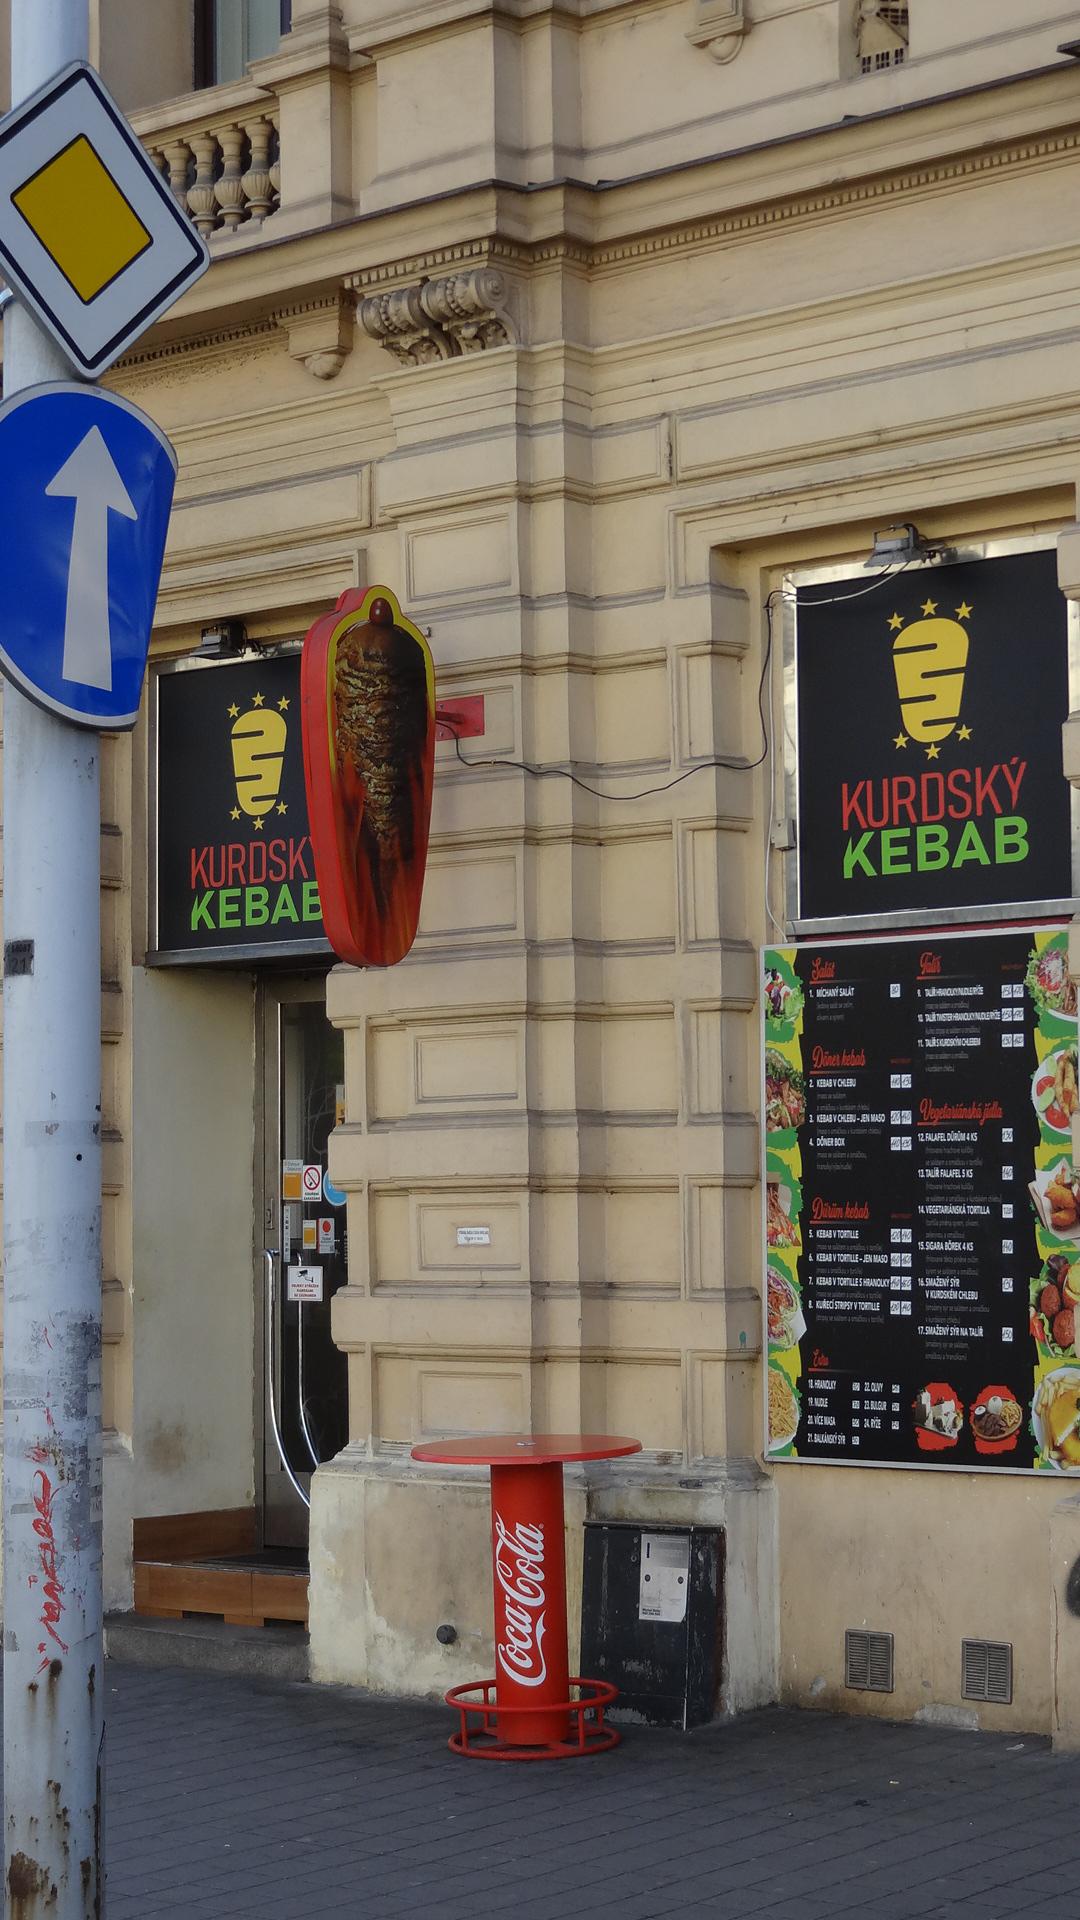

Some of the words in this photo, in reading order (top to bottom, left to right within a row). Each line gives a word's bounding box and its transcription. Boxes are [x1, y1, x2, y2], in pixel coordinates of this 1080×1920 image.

[842, 756, 1027, 831] KURDSKÝ
[843, 816, 1030, 879] KEBAB
[190, 835, 313, 890] KURDSK
[190, 881, 324, 931] KEBAB
[816, 987, 838, 997] MÍCHANÝ
[840, 986, 855, 997] SALÁT
[812, 1045, 840, 1068] Döner
[841, 1048, 866, 1066] kebab
[809, 1079, 814, 1088] 2.
[816, 1079, 832, 1087] KEBAB
[838, 1078, 856, 1087] CHLEBU
[816, 1114, 832, 1122] KEBAB
[838, 1114, 856, 1122] CHLEBU
[860, 1114, 870, 1122] JEN
[870, 1114, 886, 1122] MASO
[816, 1136, 834, 1146] DÖNER
[834, 1138, 845, 1146] BOX
[926, 1132, 946, 1141] FALAFEL
[947, 1131, 966, 1141] DÜRÜM
[970, 1132, 978, 1141] KS
[925, 1167, 940, 1178] TALÍŘ
[940, 1169, 961, 1178] FALAFEL
[966, 1169, 973, 1178] KS
[812, 1197, 843, 1220] Dürüm
[845, 1200, 869, 1219] kebab
[926, 1204, 966, 1214] VEGETARIÁNSKÁ
[967, 1206, 990, 1214] TORTILLA
[816, 1230, 832, 1238] KEBAB
[837, 1230, 859, 1238] TORTILLE
[926, 1242, 944, 1250] SIGARA
[945, 1240, 962, 1250] BÖREK
[967, 1242, 974, 1251] KS
[816, 1253, 832, 1262] KEBAB
[837, 1254, 858, 1263] TORTILLE
[863, 1255, 872, 1263] JEN
[873, 1255, 888, 1263] MASO
[809, 1276, 813, 1285] 7.
[816, 1277, 832, 1286] KEBAB
[837, 1278, 858, 1286] TORTILLE
[863, 1278, 890, 1287] HRANOLKY
[926, 1276, 949, 1287] SMAŽENÝ
[950, 1276, 960, 1287] SÝR
[930, 1290, 958, 1300] KURDSKÉM
[958, 1291, 978, 1300] CHLEBU
[816, 1299, 834, 1309] KUŘECÍ
[835, 1301, 853, 1310] STRIPSY
[858, 1302, 880, 1311] TORTILLE
[926, 1326, 949, 1336] SMAŽENÝ
[950, 1326, 960, 1336] SÝR
[960, 1328, 968, 1336] NA
[969, 1326, 983, 1337] TALÍŘ
[814, 1380, 836, 1390] HRANOLKY
[871, 1382, 883, 1392] OLIVY
[814, 1398, 828, 1407] NUDLE
[870, 1401, 887, 1411] BULGUR
[814, 1414, 823, 1425] VÍCE
[870, 1417, 881, 1428] RÝŽE
[814, 1432, 837, 1444] BALKÁNSKÝ
[838, 1433, 846, 1444] SÝR
